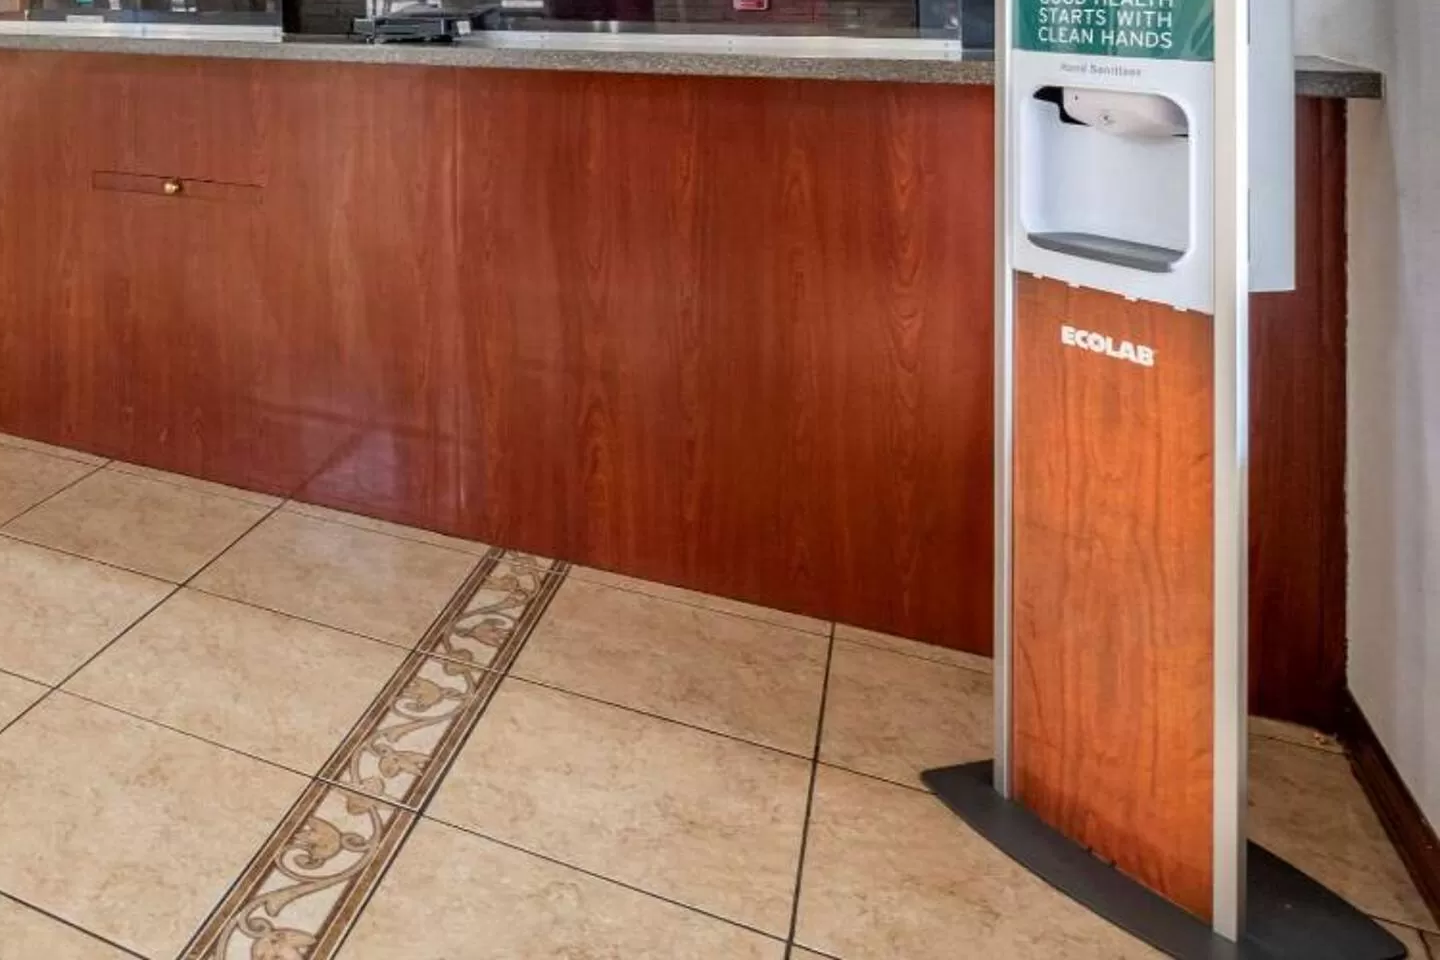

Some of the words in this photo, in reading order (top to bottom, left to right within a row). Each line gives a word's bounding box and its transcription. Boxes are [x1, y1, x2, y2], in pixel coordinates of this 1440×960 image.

[1038, 7, 1107, 26] STARTS
[1116, 10, 1172, 28] WITH
[1037, 26, 1094, 45] CLEAN
[1100, 29, 1173, 50] HANDS
[1060, 324, 1154, 367] ECOLAB
